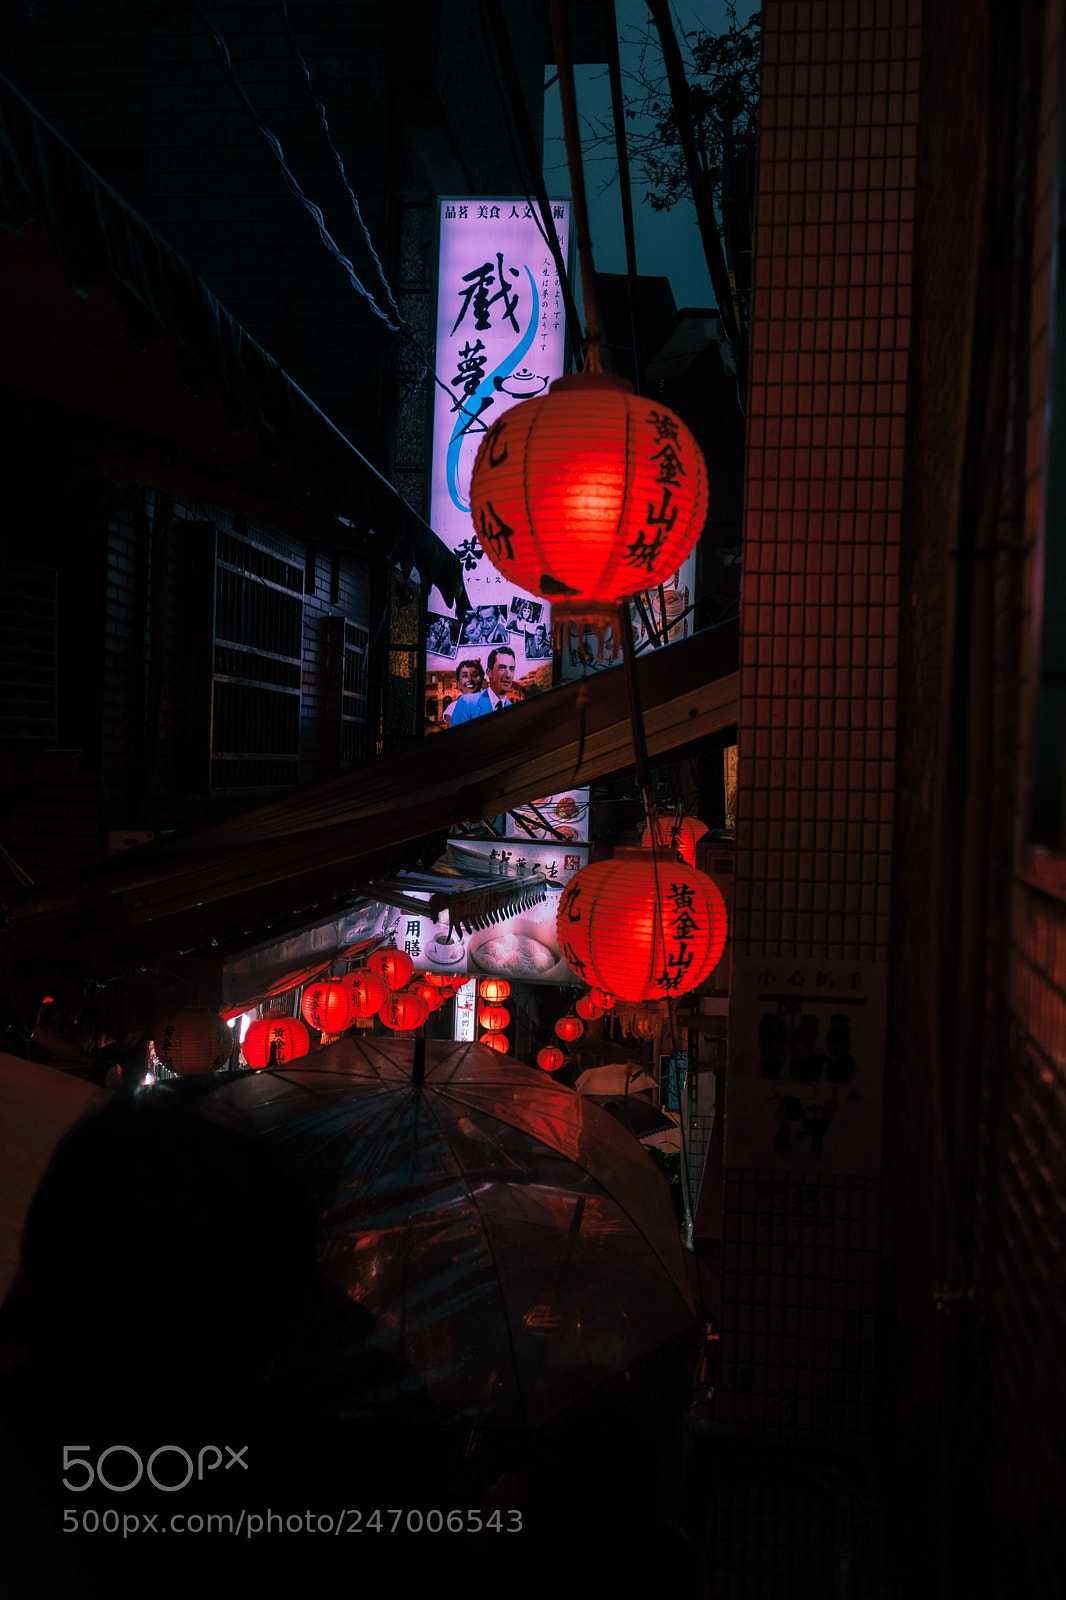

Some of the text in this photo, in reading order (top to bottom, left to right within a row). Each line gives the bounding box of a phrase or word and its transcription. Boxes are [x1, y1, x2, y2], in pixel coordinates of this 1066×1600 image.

[445, 205, 469, 219] 品茗
[477, 205, 501, 219] 美食
[404, 920, 422, 957] 用膳
